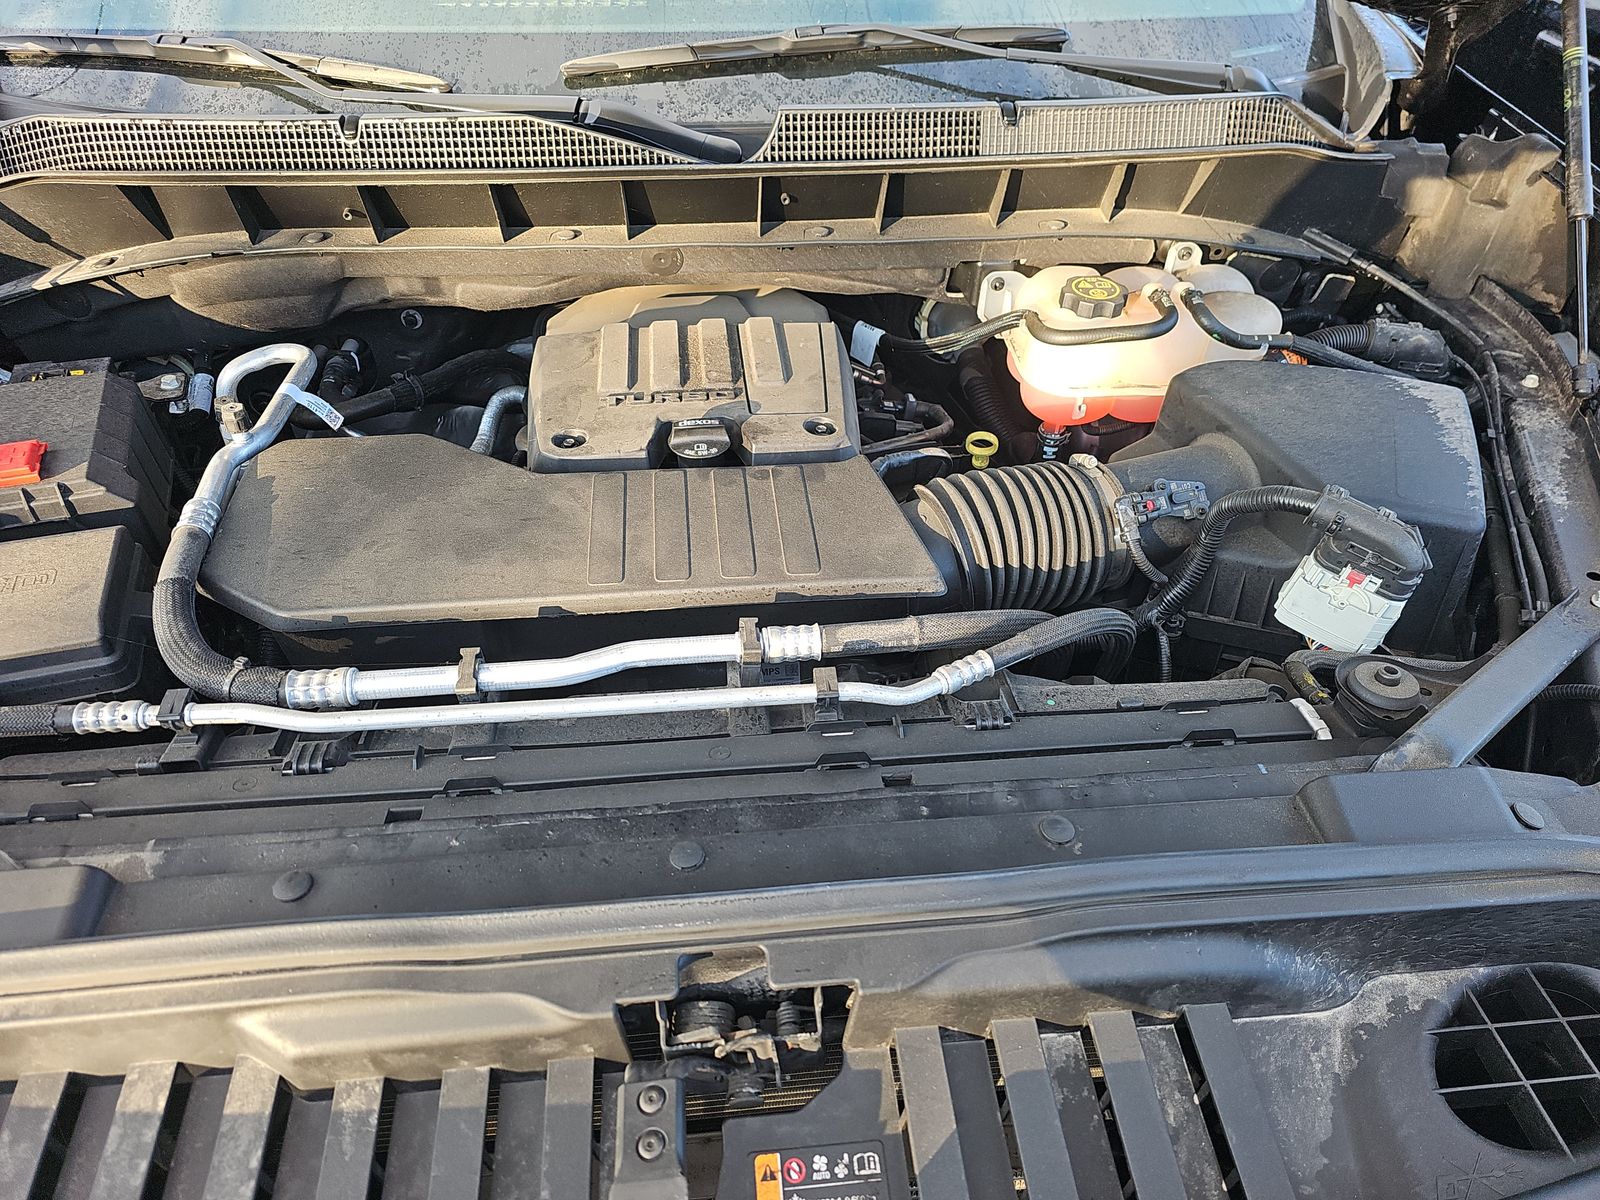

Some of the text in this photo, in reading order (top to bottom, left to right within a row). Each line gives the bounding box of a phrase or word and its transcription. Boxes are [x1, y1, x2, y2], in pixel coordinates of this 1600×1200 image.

[606, 388, 737, 406] TURBO
[678, 419, 720, 427] dexos
[812, 1170, 831, 1181] AUTO
